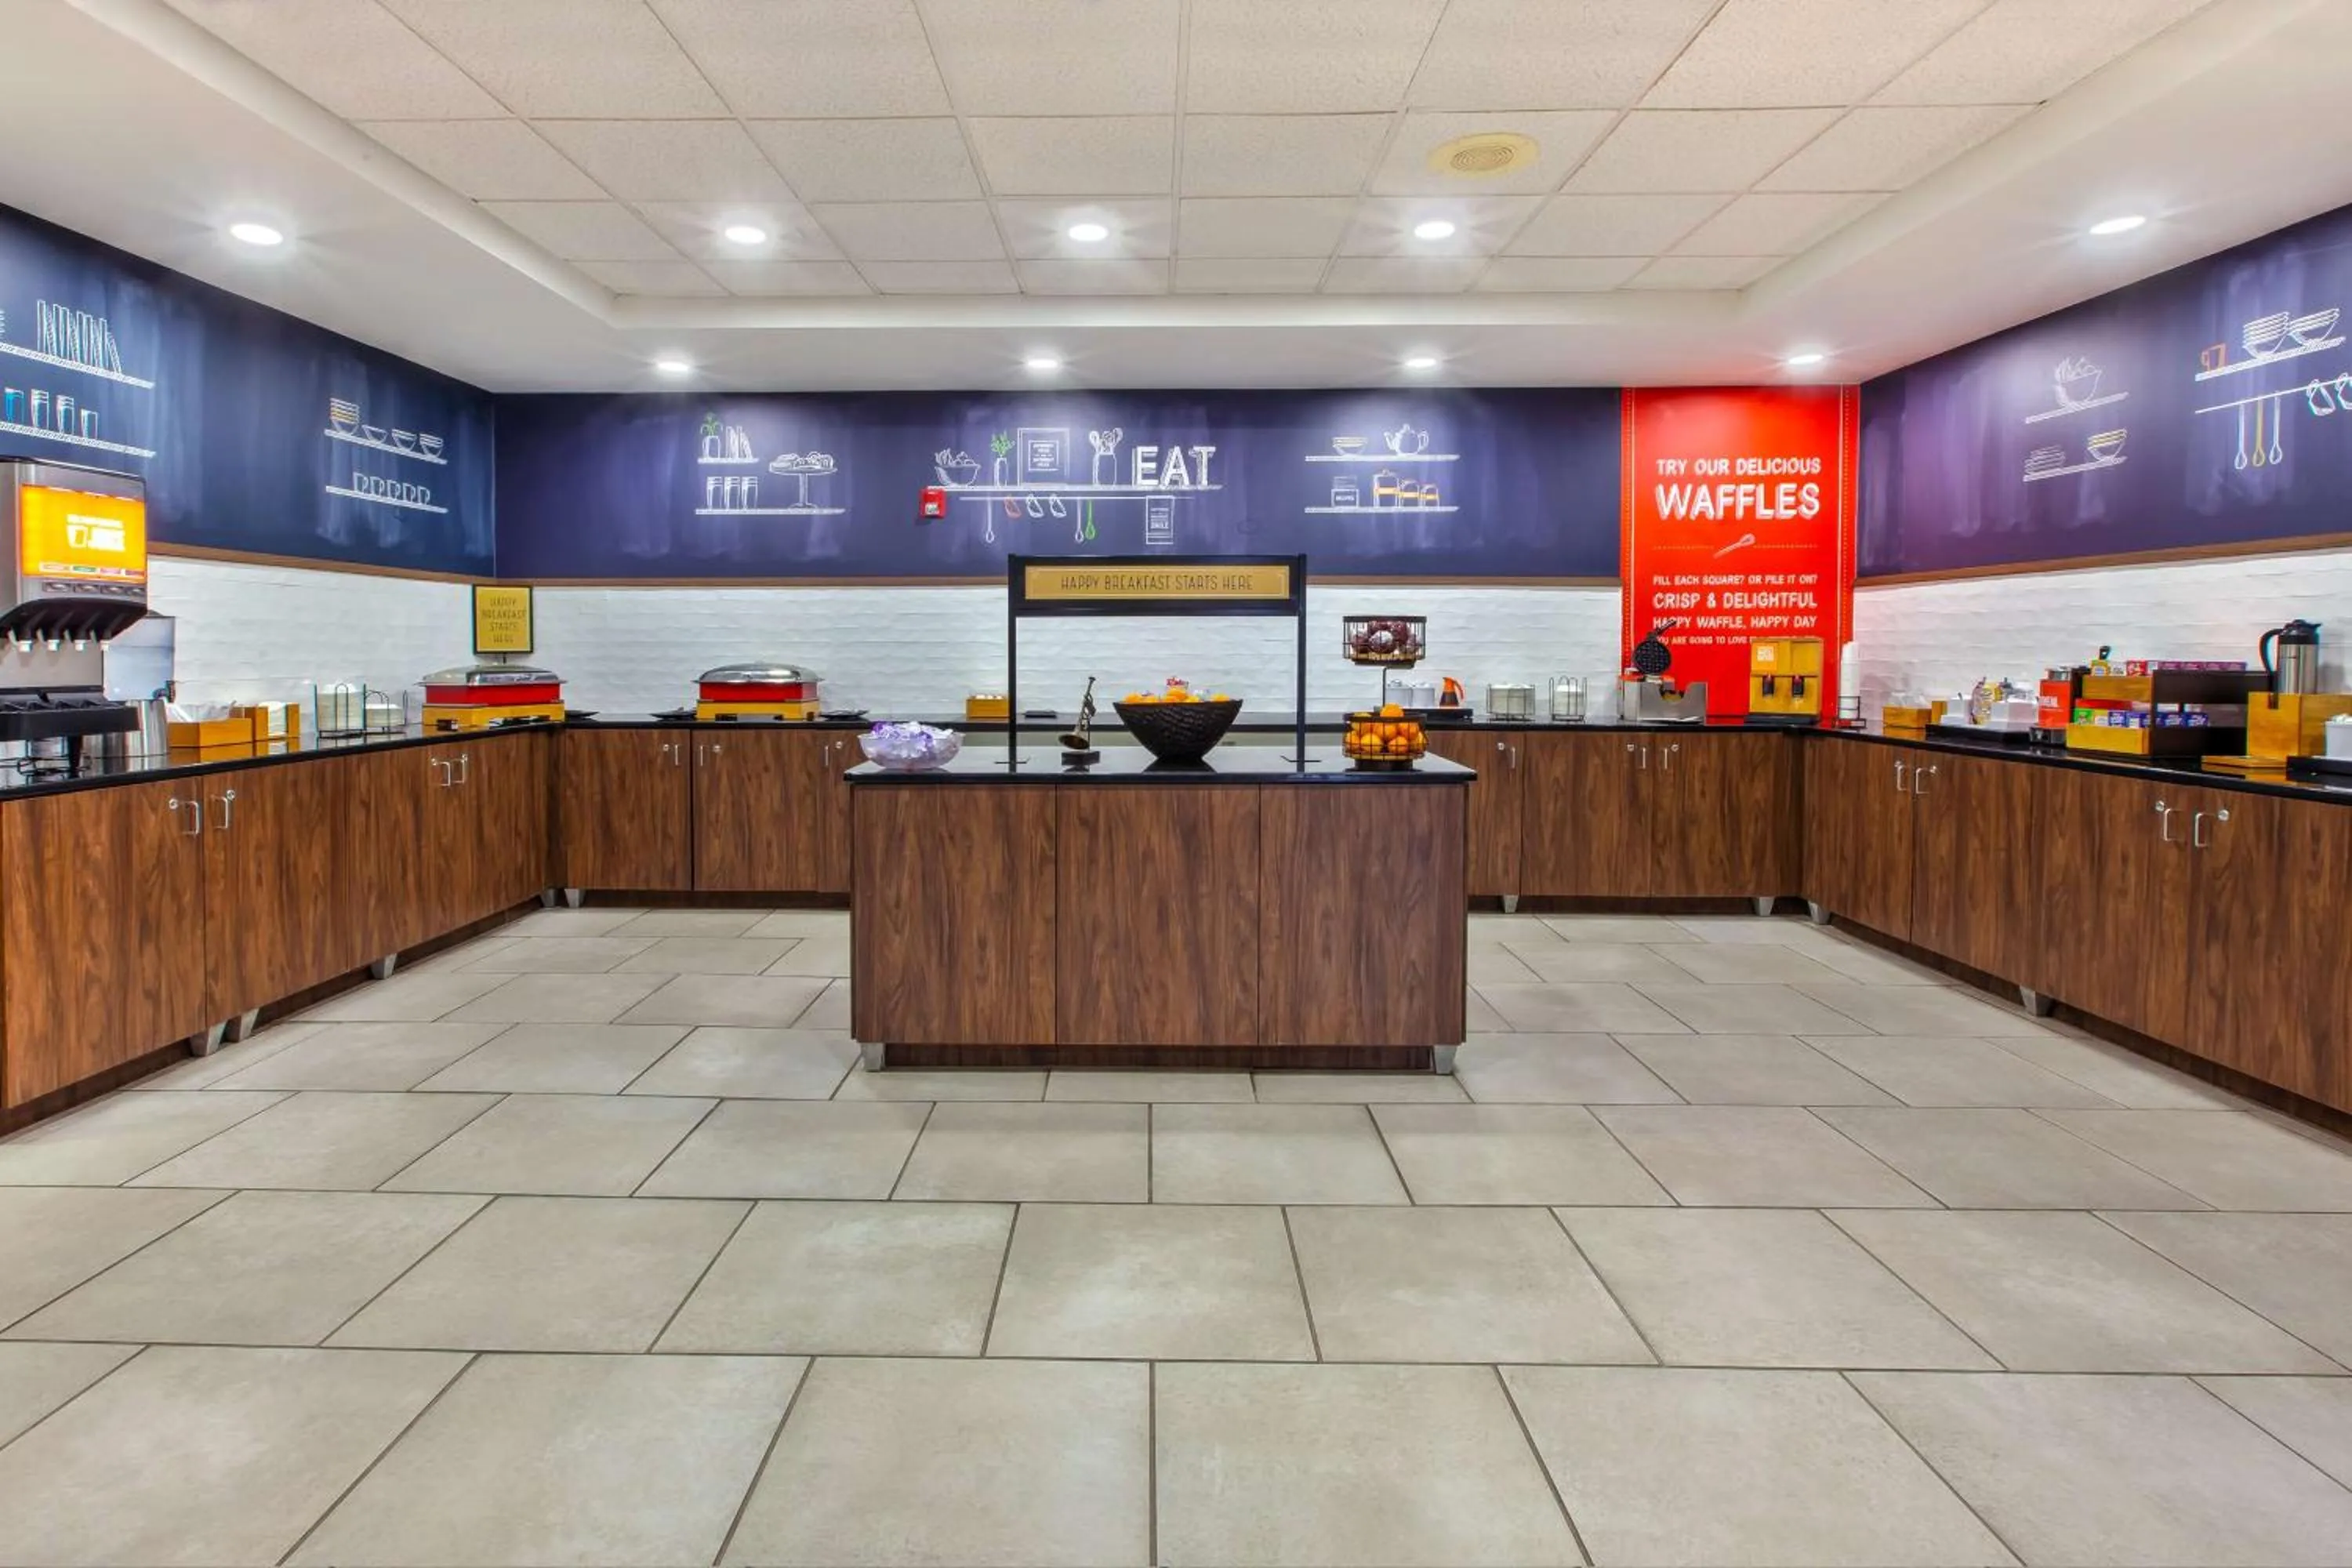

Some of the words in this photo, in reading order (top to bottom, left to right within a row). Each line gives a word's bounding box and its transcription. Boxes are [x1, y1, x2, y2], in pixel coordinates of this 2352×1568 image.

[1132, 445, 1216, 489] EAT
[1656, 459, 1687, 476] TRY
[1694, 458, 1730, 476] OUR
[1735, 457, 1822, 475] DELICIOUS
[1655, 482, 1820, 521] WAFFLES
[1061, 575, 1099, 590] HAPPY
[1105, 575, 1171, 590] BREAKFAST
[1176, 575, 1218, 590] STARTS
[1223, 575, 1253, 590] HERE
[1653, 575, 1671, 586] FILL
[1675, 575, 1700, 586] EACH
[1703, 575, 1744, 586] SQUARE?
[1748, 575, 1762, 585] OR
[1765, 575, 1784, 585] PILE
[1788, 575, 1795, 584] IT
[1653, 593, 1700, 609] CRISP
[1707, 593, 1716, 609] &
[1723, 592, 1817, 608] DELIGHTFUL
[1751, 615, 1789, 628] HAPPY
[1794, 615, 1817, 628] DAY
[1671, 636, 1687, 644] ARE
[1689, 636, 1713, 644] GOING
[1715, 636, 1726, 644] TO
[1728, 636, 1748, 644] LOVE
